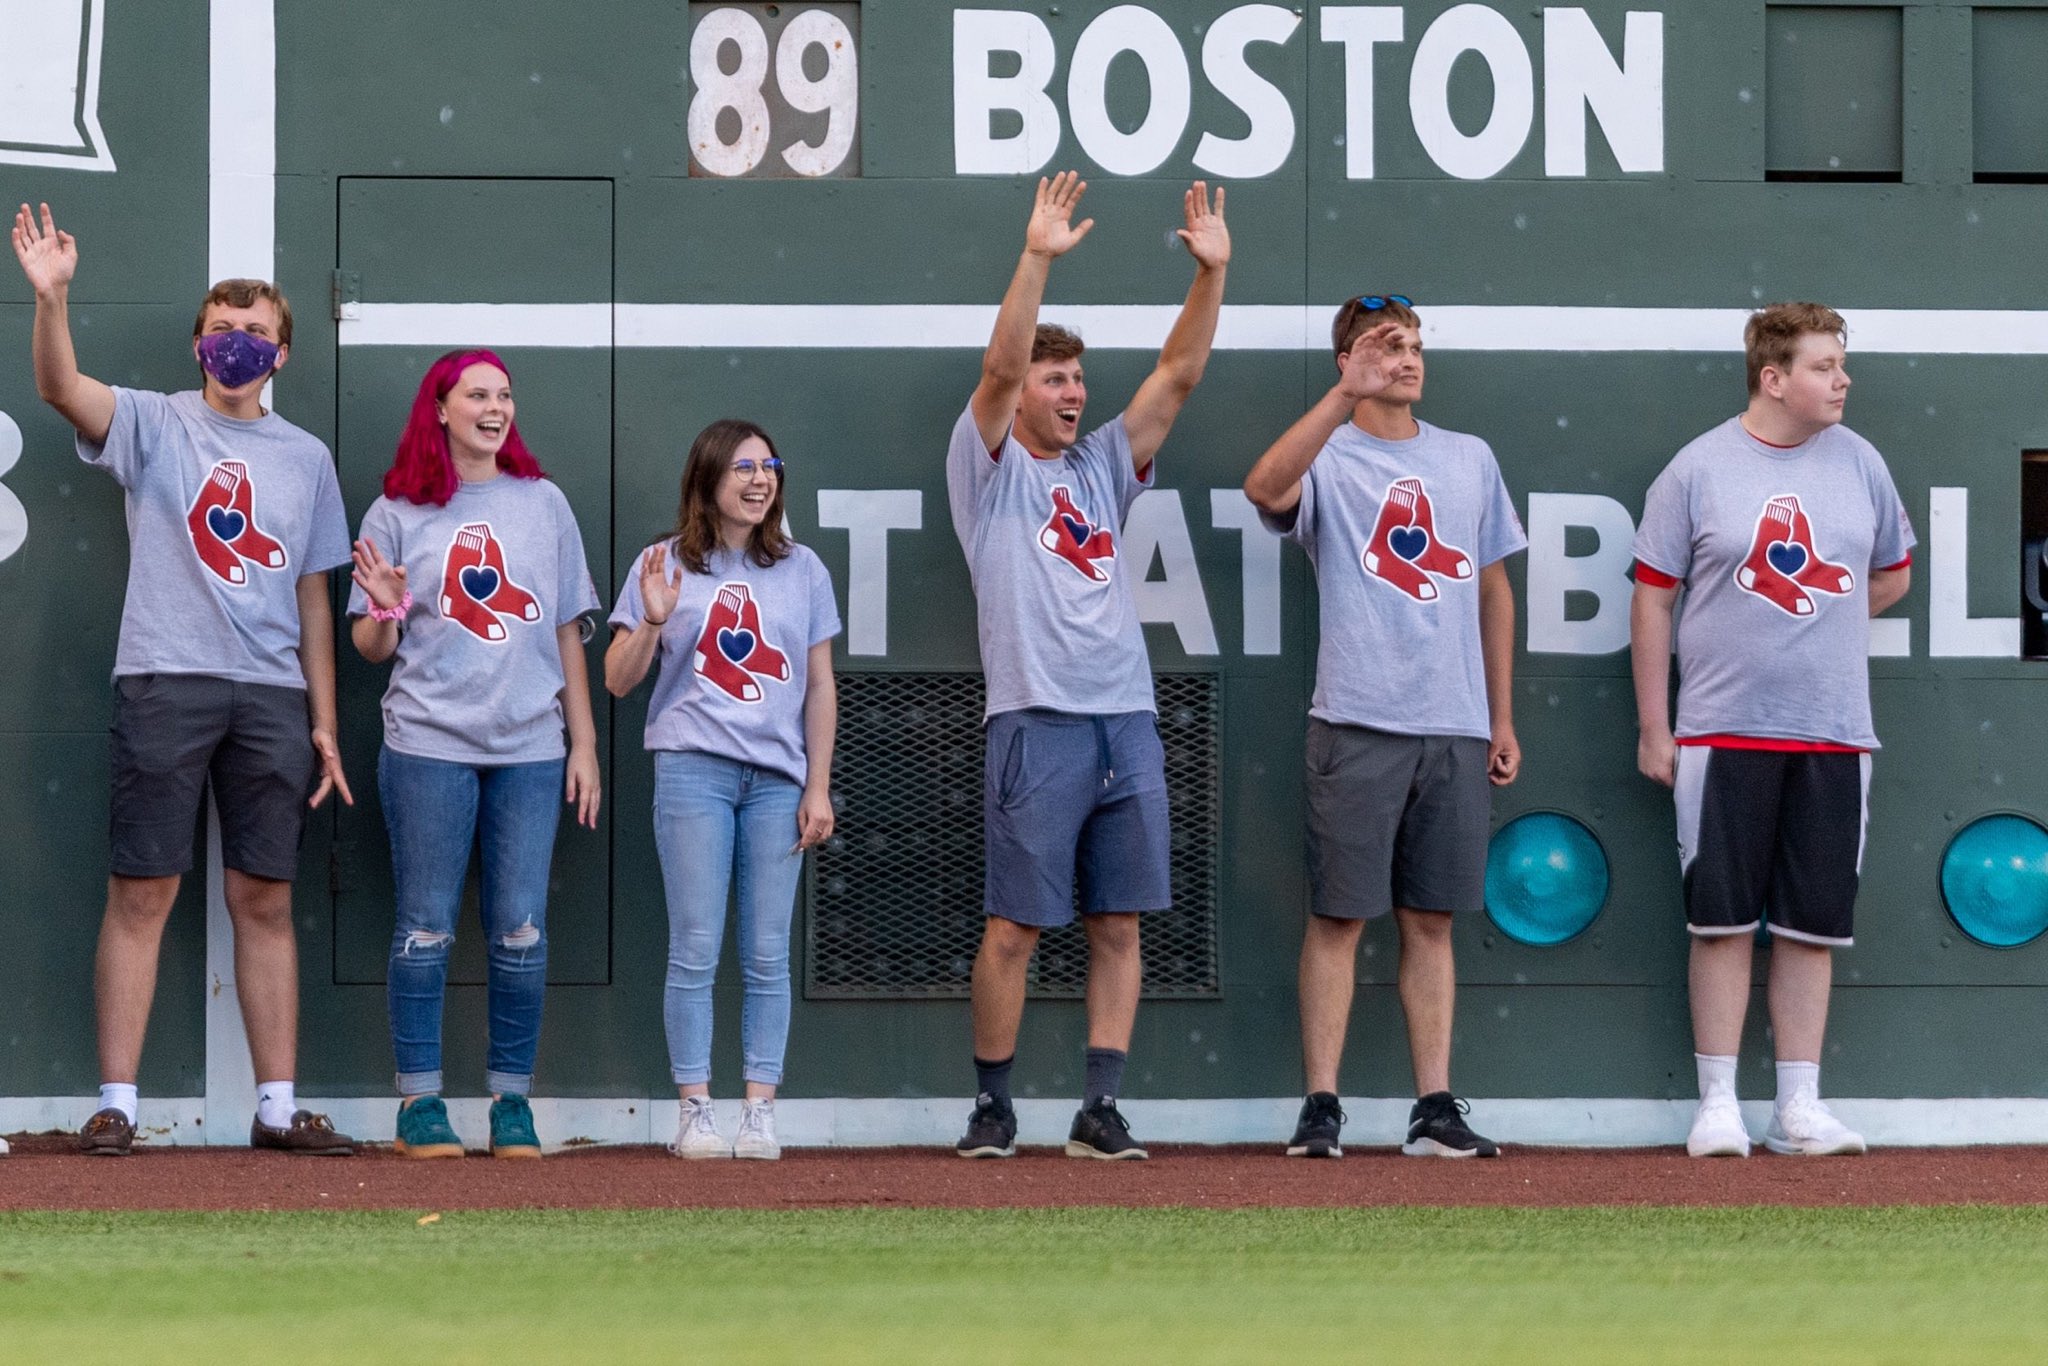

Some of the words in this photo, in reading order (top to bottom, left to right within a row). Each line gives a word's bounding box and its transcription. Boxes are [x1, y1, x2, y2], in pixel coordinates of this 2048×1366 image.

[687, 7, 858, 177] 89
[953, 4, 1664, 180] BOSTON
[781, 489, 922, 656] T
[1119, 489, 1281, 656] AT
[1527, 487, 2021, 657] BL
